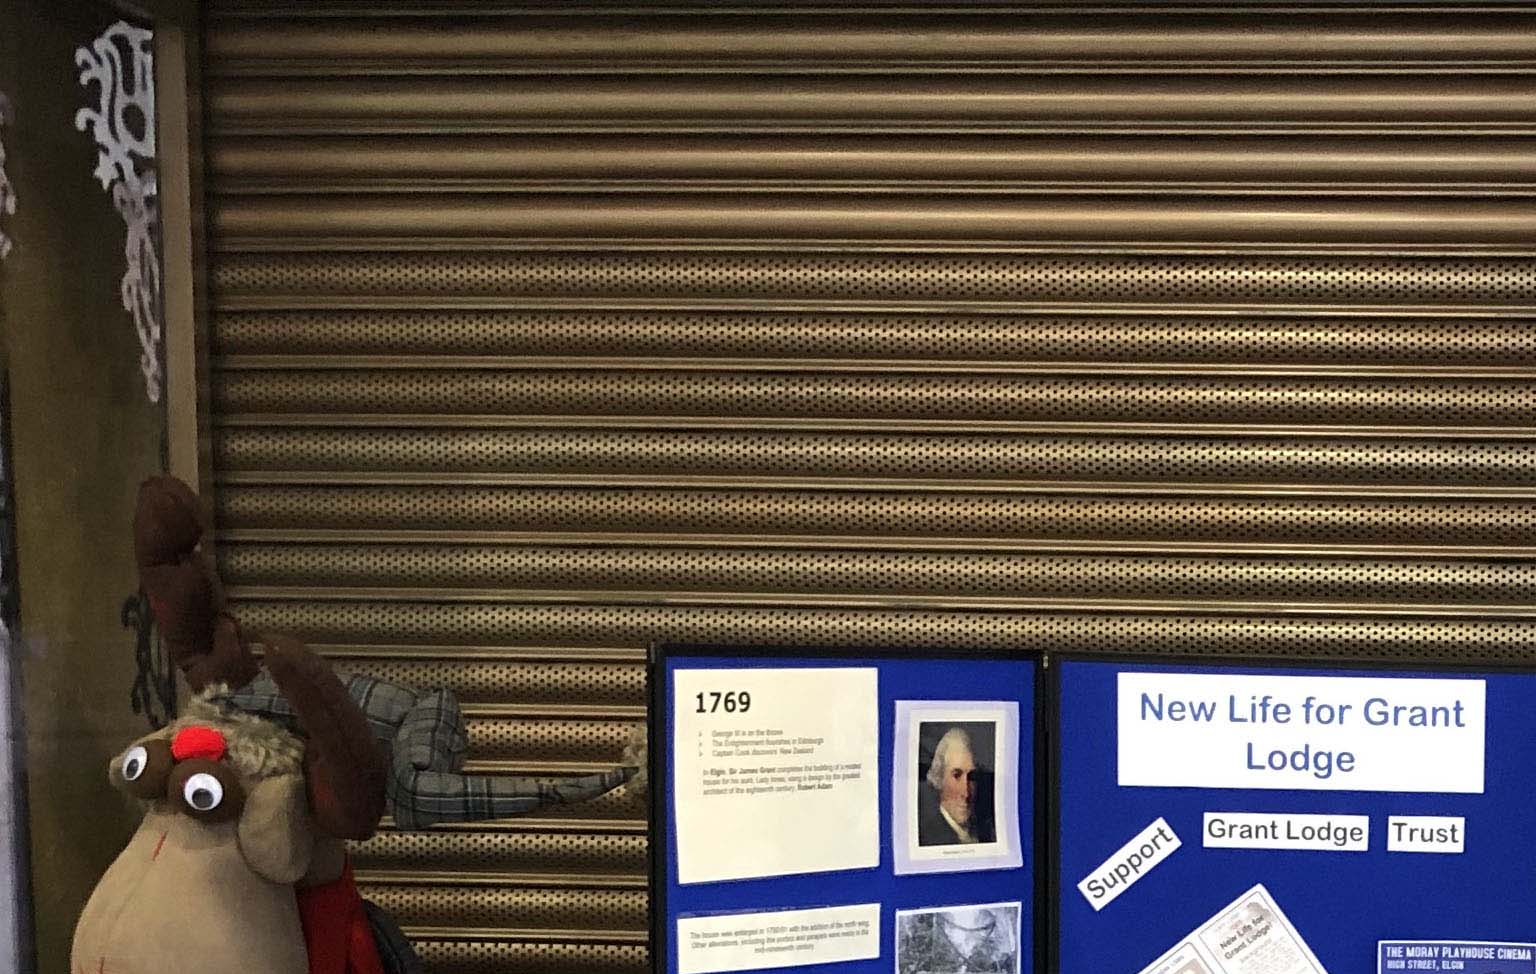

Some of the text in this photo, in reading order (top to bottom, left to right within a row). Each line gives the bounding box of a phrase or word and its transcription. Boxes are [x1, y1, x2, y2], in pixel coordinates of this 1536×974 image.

[695, 691, 751, 713] 1769
[1141, 692, 1466, 729] New Life for Grant
[1246, 742, 1356, 780] Lodge
[1207, 819, 1460, 848] Grant Lodge Trust
[1086, 825, 1174, 900] Support
[1386, 946, 1532, 961] THE MORAY PLAYHOUSE CINEMA
